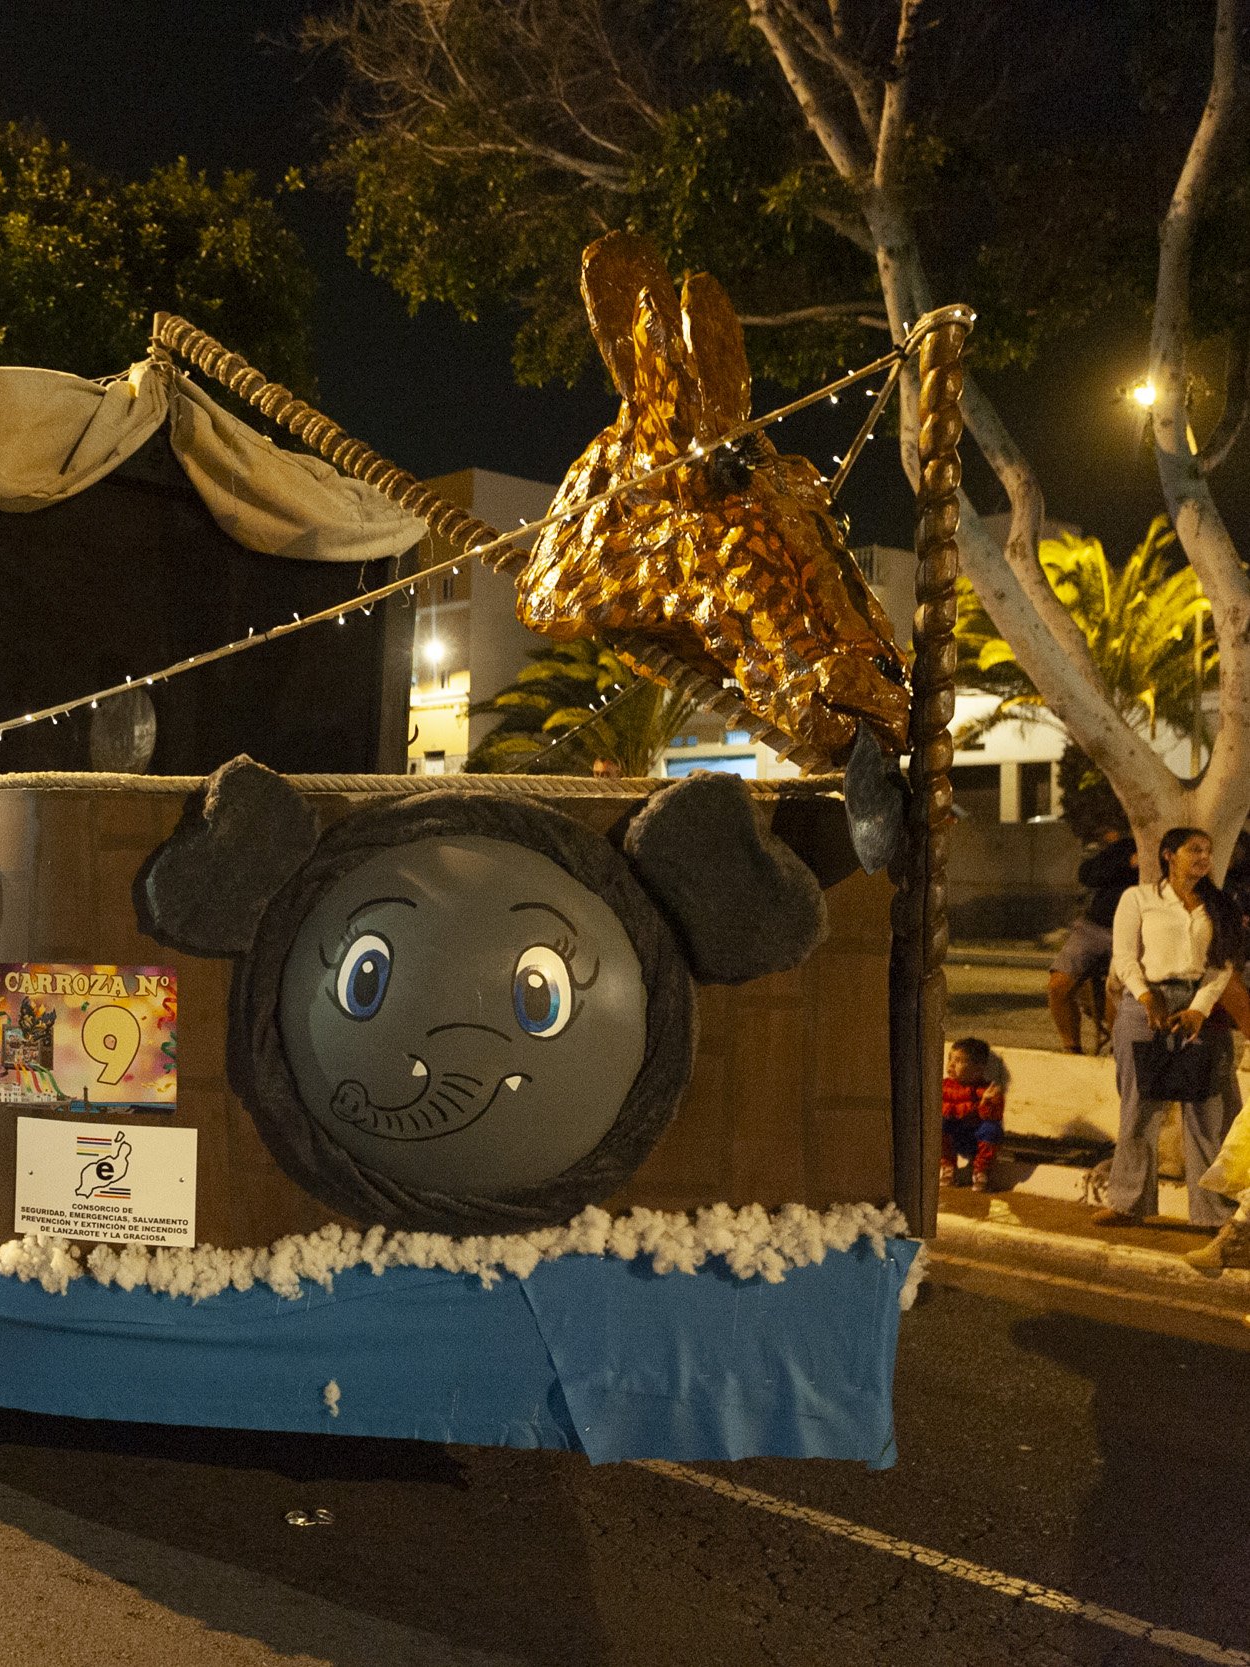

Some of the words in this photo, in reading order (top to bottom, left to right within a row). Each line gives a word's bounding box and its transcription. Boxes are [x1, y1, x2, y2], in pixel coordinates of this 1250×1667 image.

[4, 972, 129, 998] CARROZA
[81, 1004, 142, 1086] 9
[96, 1162, 114, 1181] e
[20, 1206, 67, 1218] SEGURIDAD,
[69, 1211, 130, 1223] EMERGENCIAS,
[132, 1216, 189, 1226] SALVAMENTO
[71, 1203, 120, 1213] CONSORCIO
[52, 1226, 100, 1237] LANZAROTE
[123, 1233, 166, 1242] GRACIOSA
[141, 1225, 188, 1234] INCENDIOS
